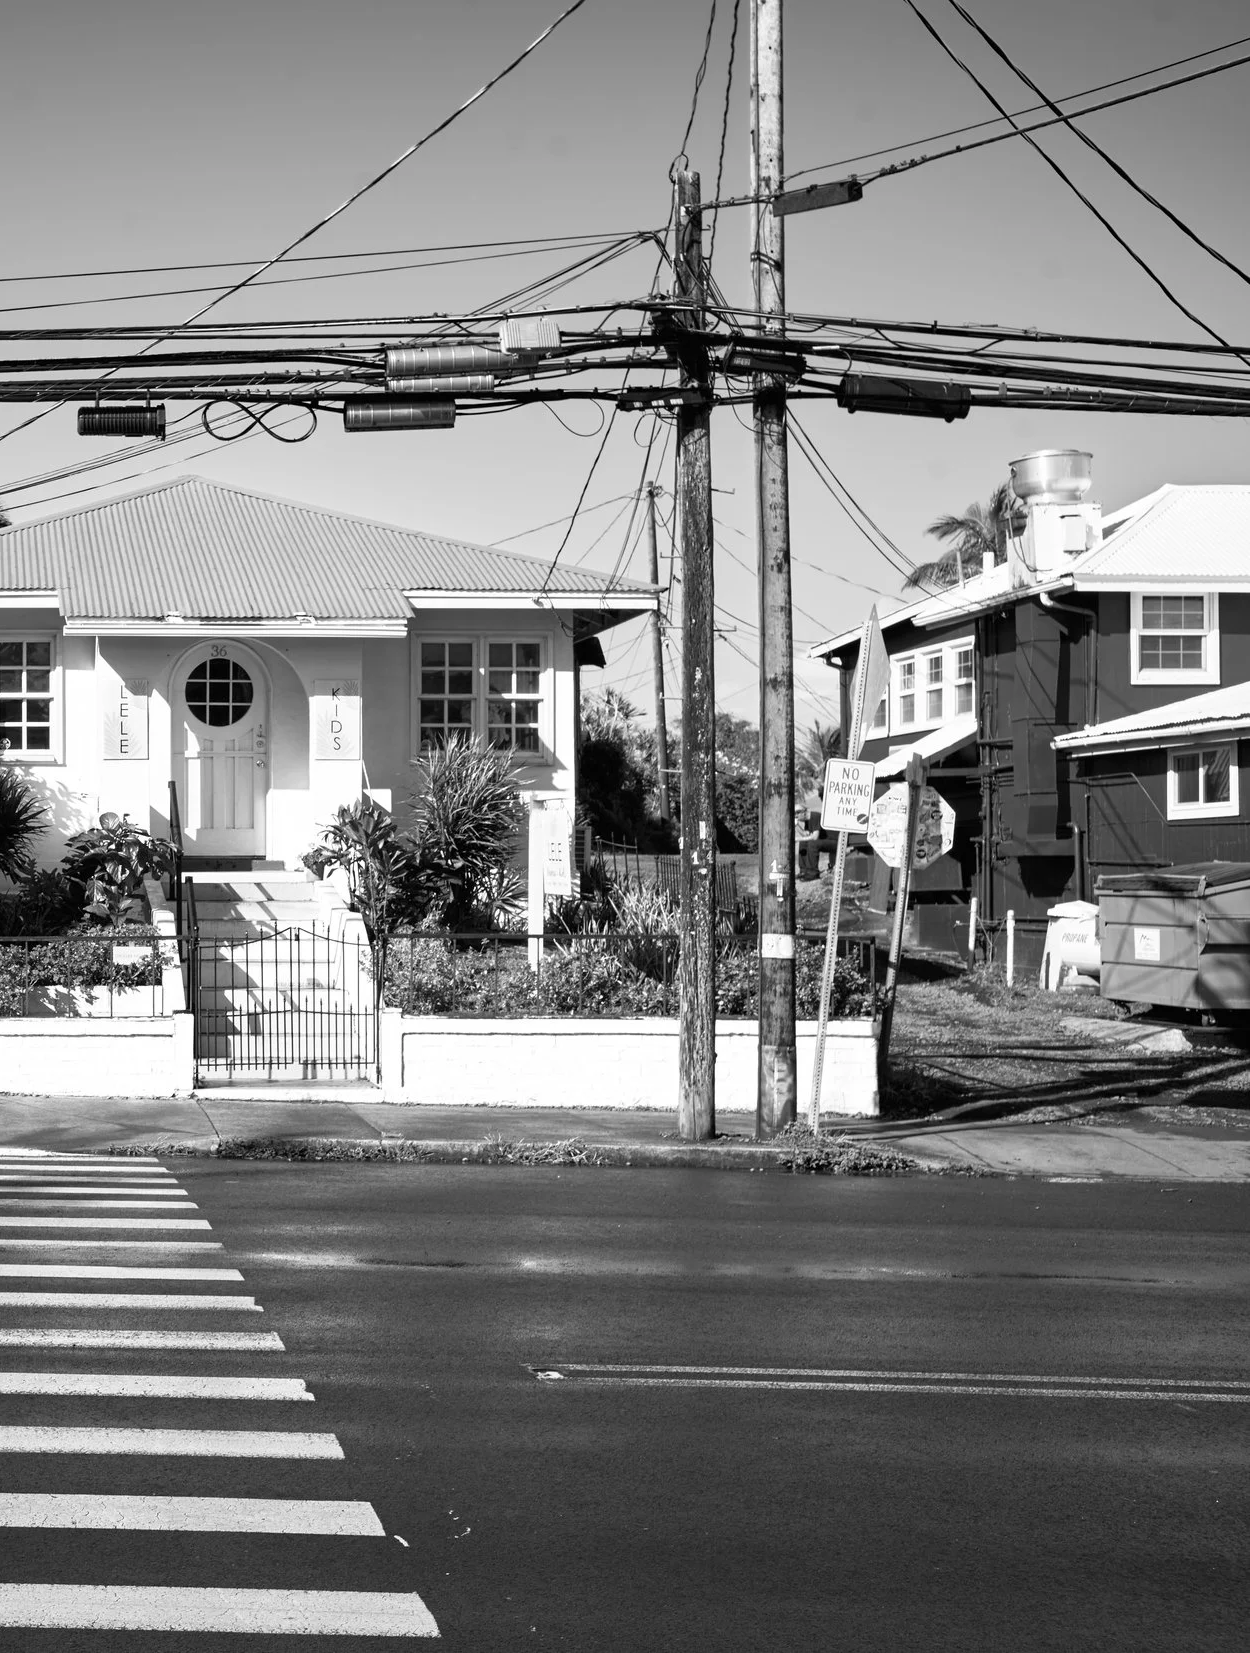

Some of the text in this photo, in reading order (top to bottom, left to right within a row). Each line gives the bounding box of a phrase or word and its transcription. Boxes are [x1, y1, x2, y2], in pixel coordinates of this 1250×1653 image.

[210, 645, 227, 658] 36
[120, 684, 129, 754] LELE
[330, 687, 343, 751] KIDS
[842, 767, 860, 781] NO
[828, 781, 870, 797] PARKING
[838, 797, 858, 806] ANY
[837, 806, 858, 817] TIME
[1062, 932, 1089, 943] PROPANE
